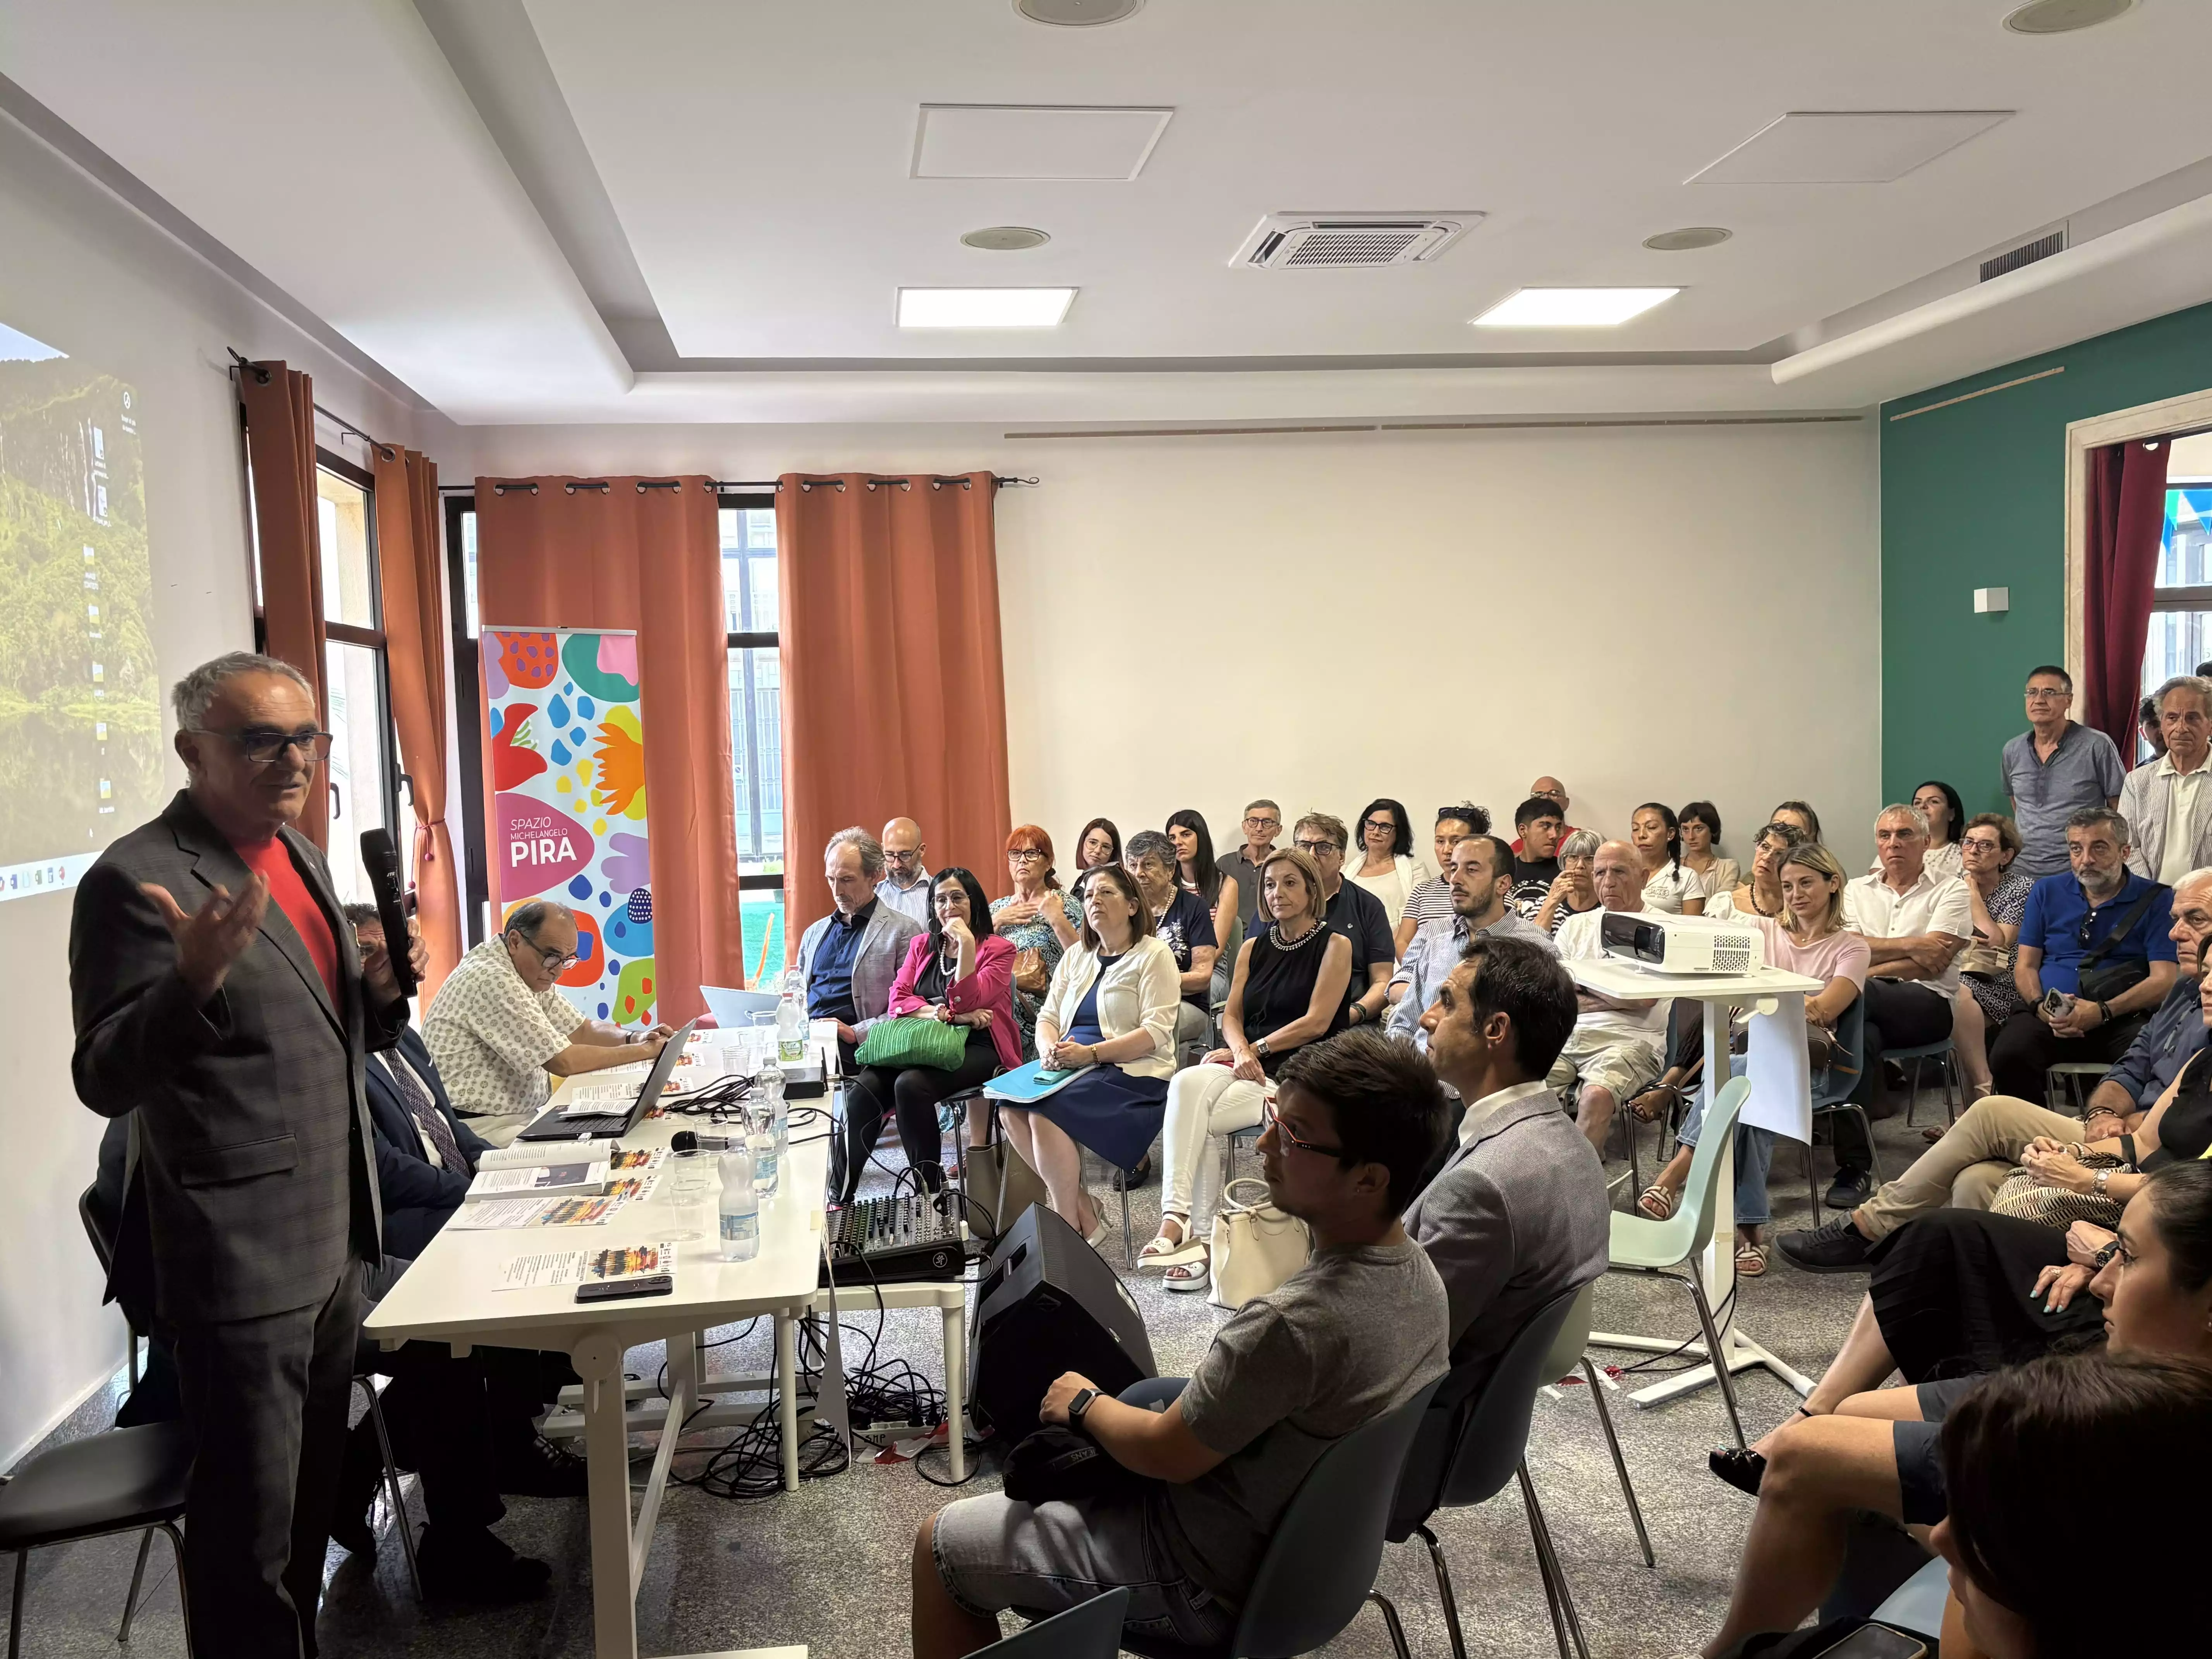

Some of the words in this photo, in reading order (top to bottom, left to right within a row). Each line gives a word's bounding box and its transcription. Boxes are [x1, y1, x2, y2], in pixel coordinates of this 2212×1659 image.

[510, 816, 551, 831] SPAZIO
[510, 828, 568, 840] MICHELANGELO
[510, 836, 577, 867] PIRA
